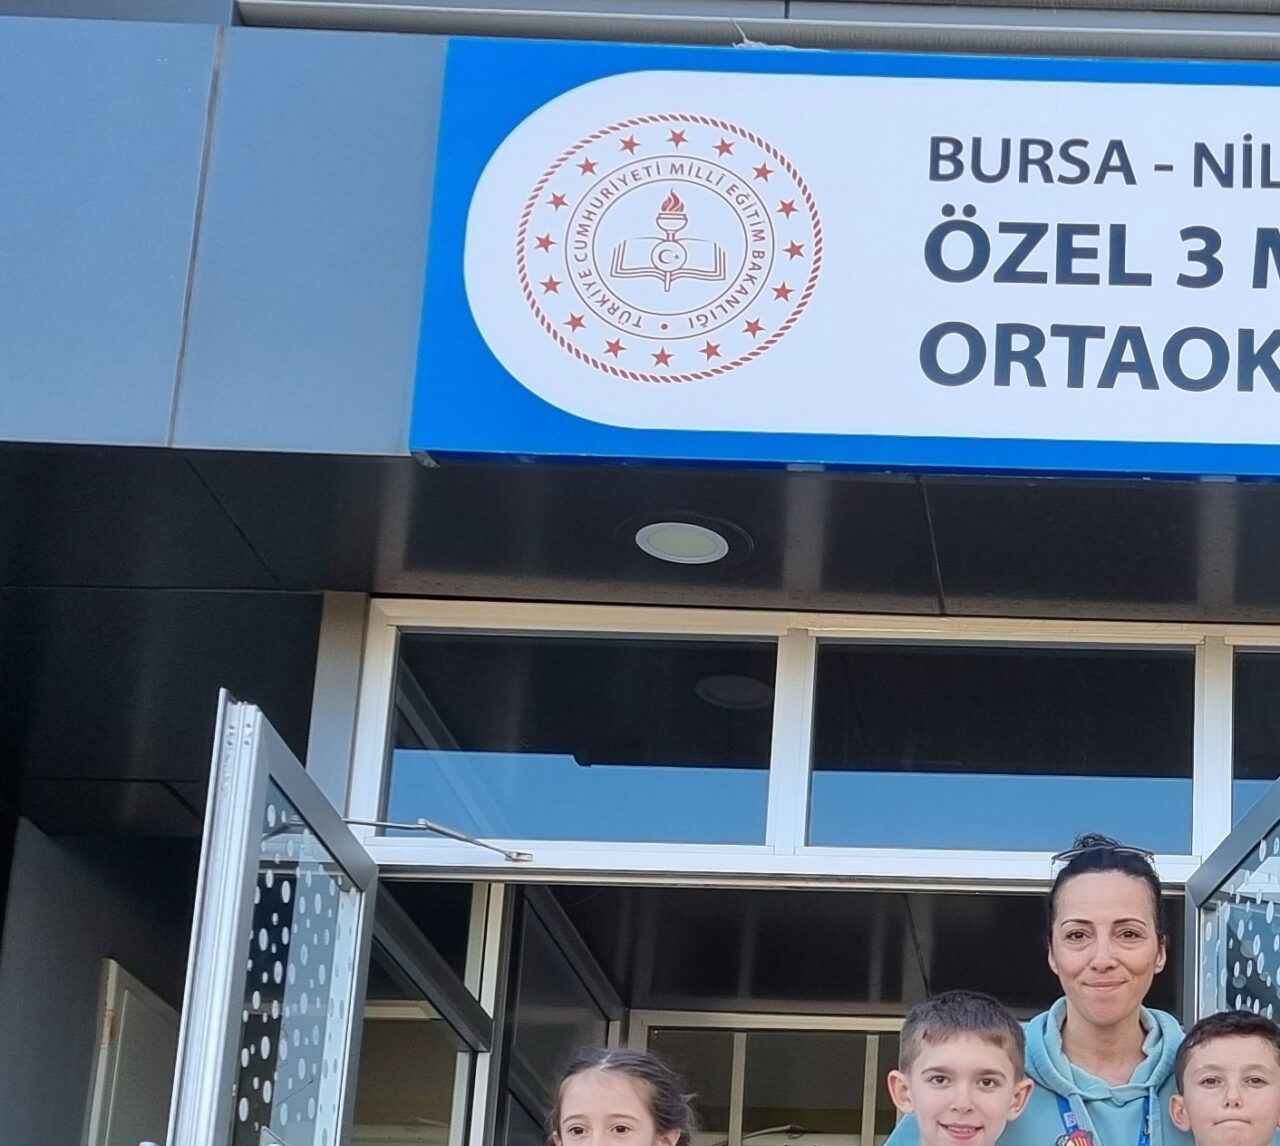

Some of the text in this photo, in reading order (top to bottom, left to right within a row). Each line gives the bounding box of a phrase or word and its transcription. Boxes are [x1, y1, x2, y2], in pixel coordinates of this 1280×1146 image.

[930, 137, 1136, 185] BURSA
[574, 161, 661, 263] CUMHURİYETİ
[725, 183, 766, 242] EĞİTİM
[925, 204, 1152, 286] ÖZEL
[1177, 226, 1223, 288] 3
[578, 268, 644, 329] TÜRKİYE
[689, 250, 766, 329] BAKANLIĞI
